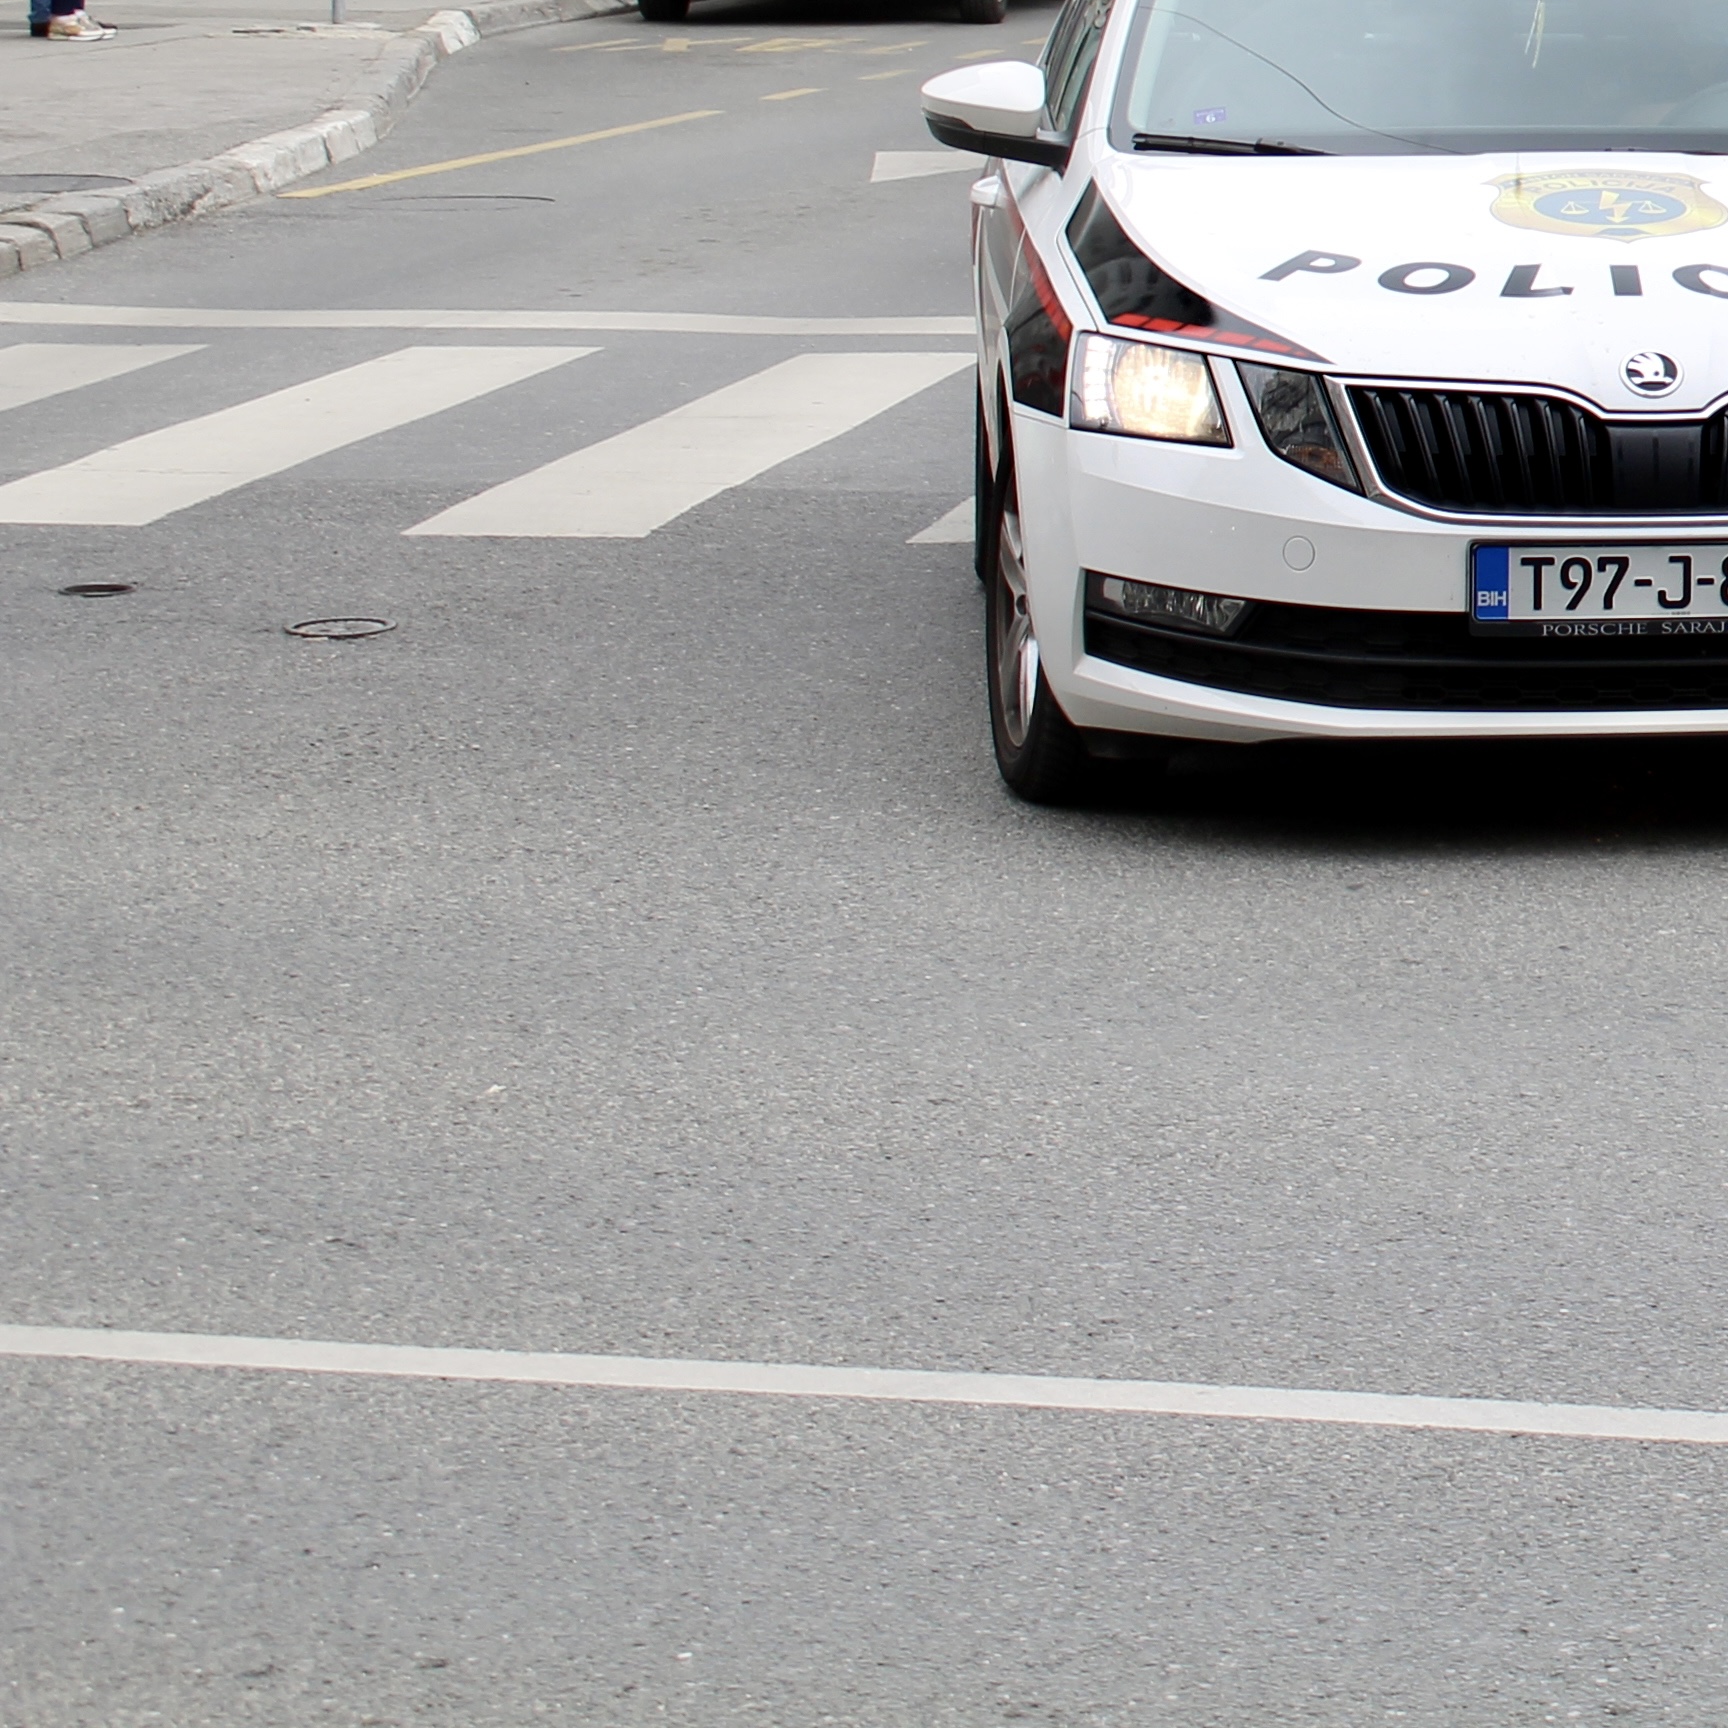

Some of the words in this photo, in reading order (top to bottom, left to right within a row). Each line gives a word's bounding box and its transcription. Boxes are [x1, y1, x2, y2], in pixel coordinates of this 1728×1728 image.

[1522, 177, 1677, 194] POLICIJA
[1476, 590, 1507, 607] BIH
[1542, 622, 1648, 637] PORSCHE
